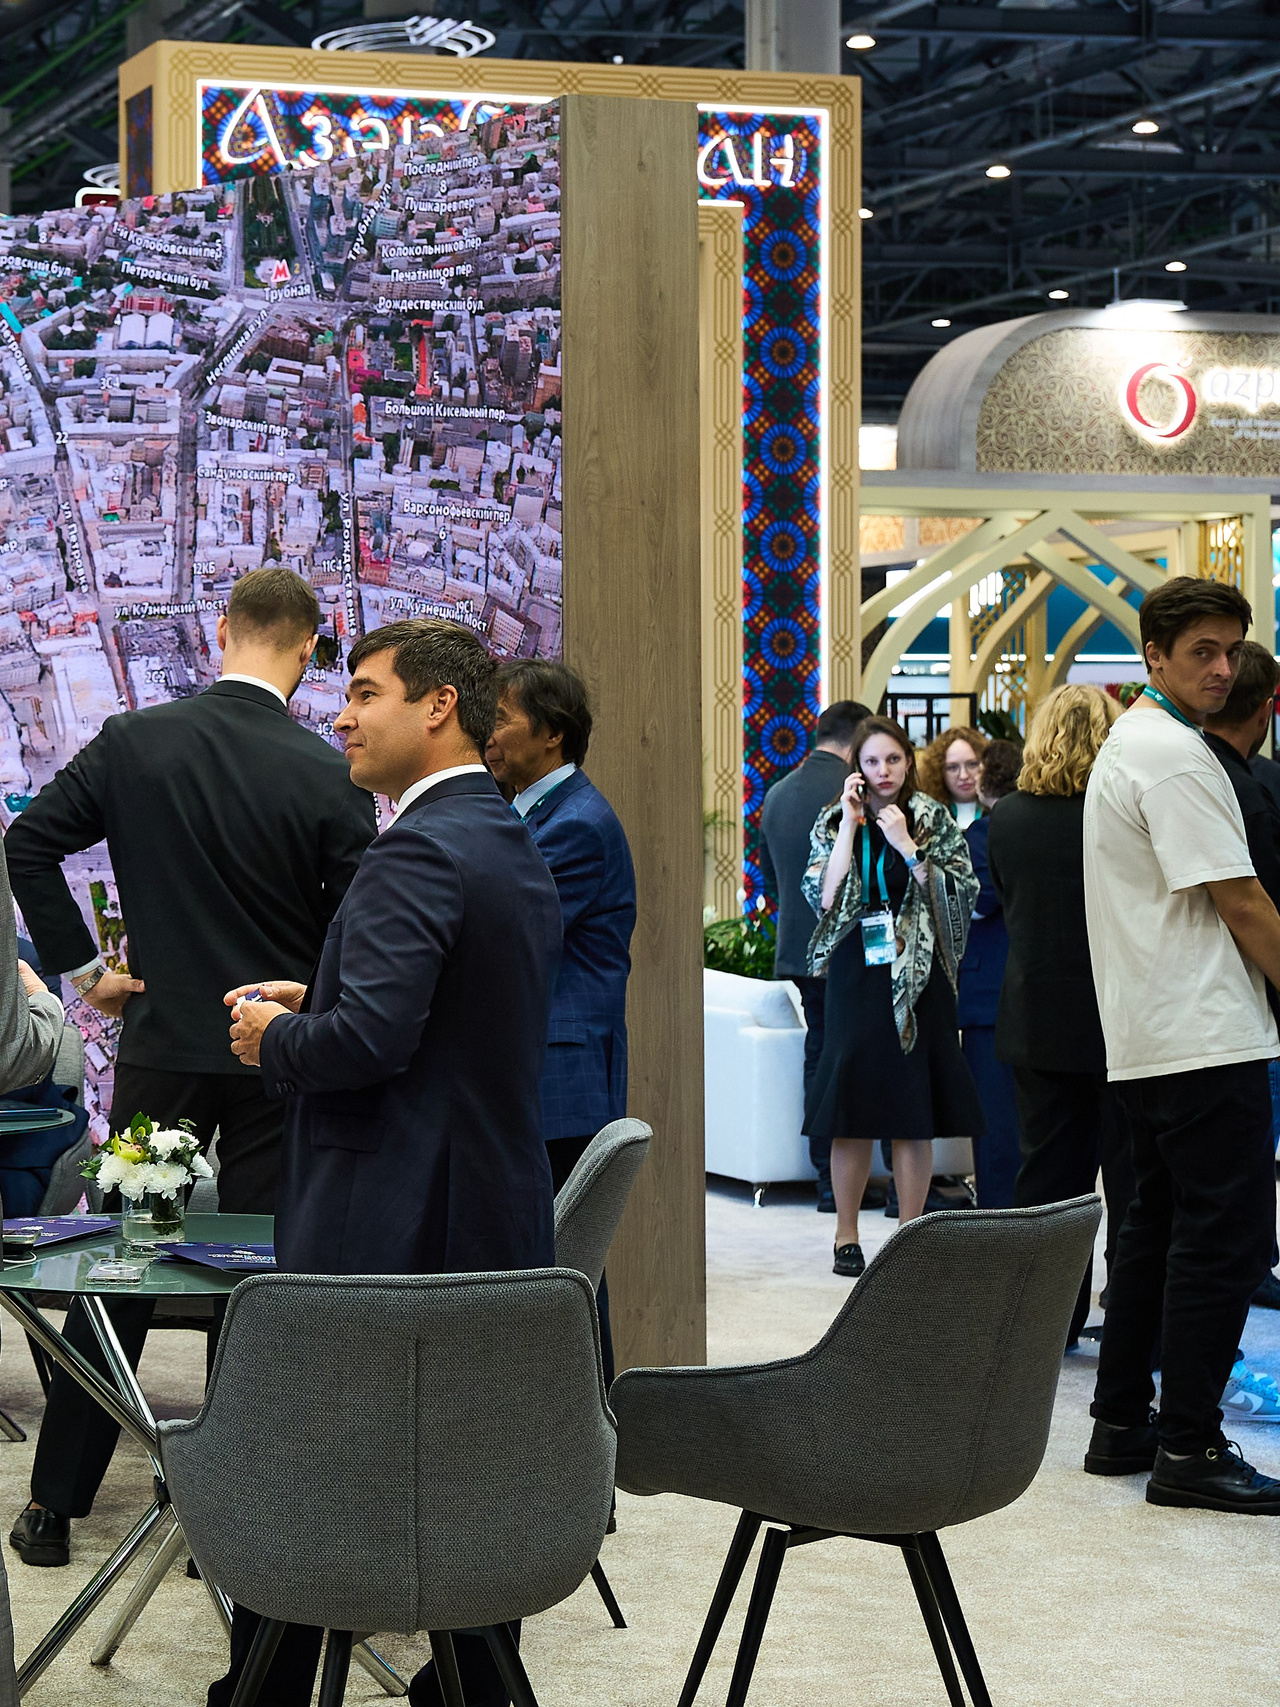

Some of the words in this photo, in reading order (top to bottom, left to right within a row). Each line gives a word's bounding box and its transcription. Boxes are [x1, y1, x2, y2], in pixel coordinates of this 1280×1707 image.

[404, 156, 462, 177] Последний
[405, 197, 457, 215] Пушкарев
[381, 239, 464, 258] Колокольников
[121, 262, 188, 285] Петровский
[391, 266, 454, 283] Печатников
[264, 283, 311, 303] Трубная
[378, 296, 466, 312] Рождественский
[385, 401, 434, 416] Большой
[435, 403, 488, 419] Кисельный
[205, 411, 268, 434] Звонарский
[196, 465, 274, 482] Сандуновский
[403, 500, 492, 520] Варсонофьевский
